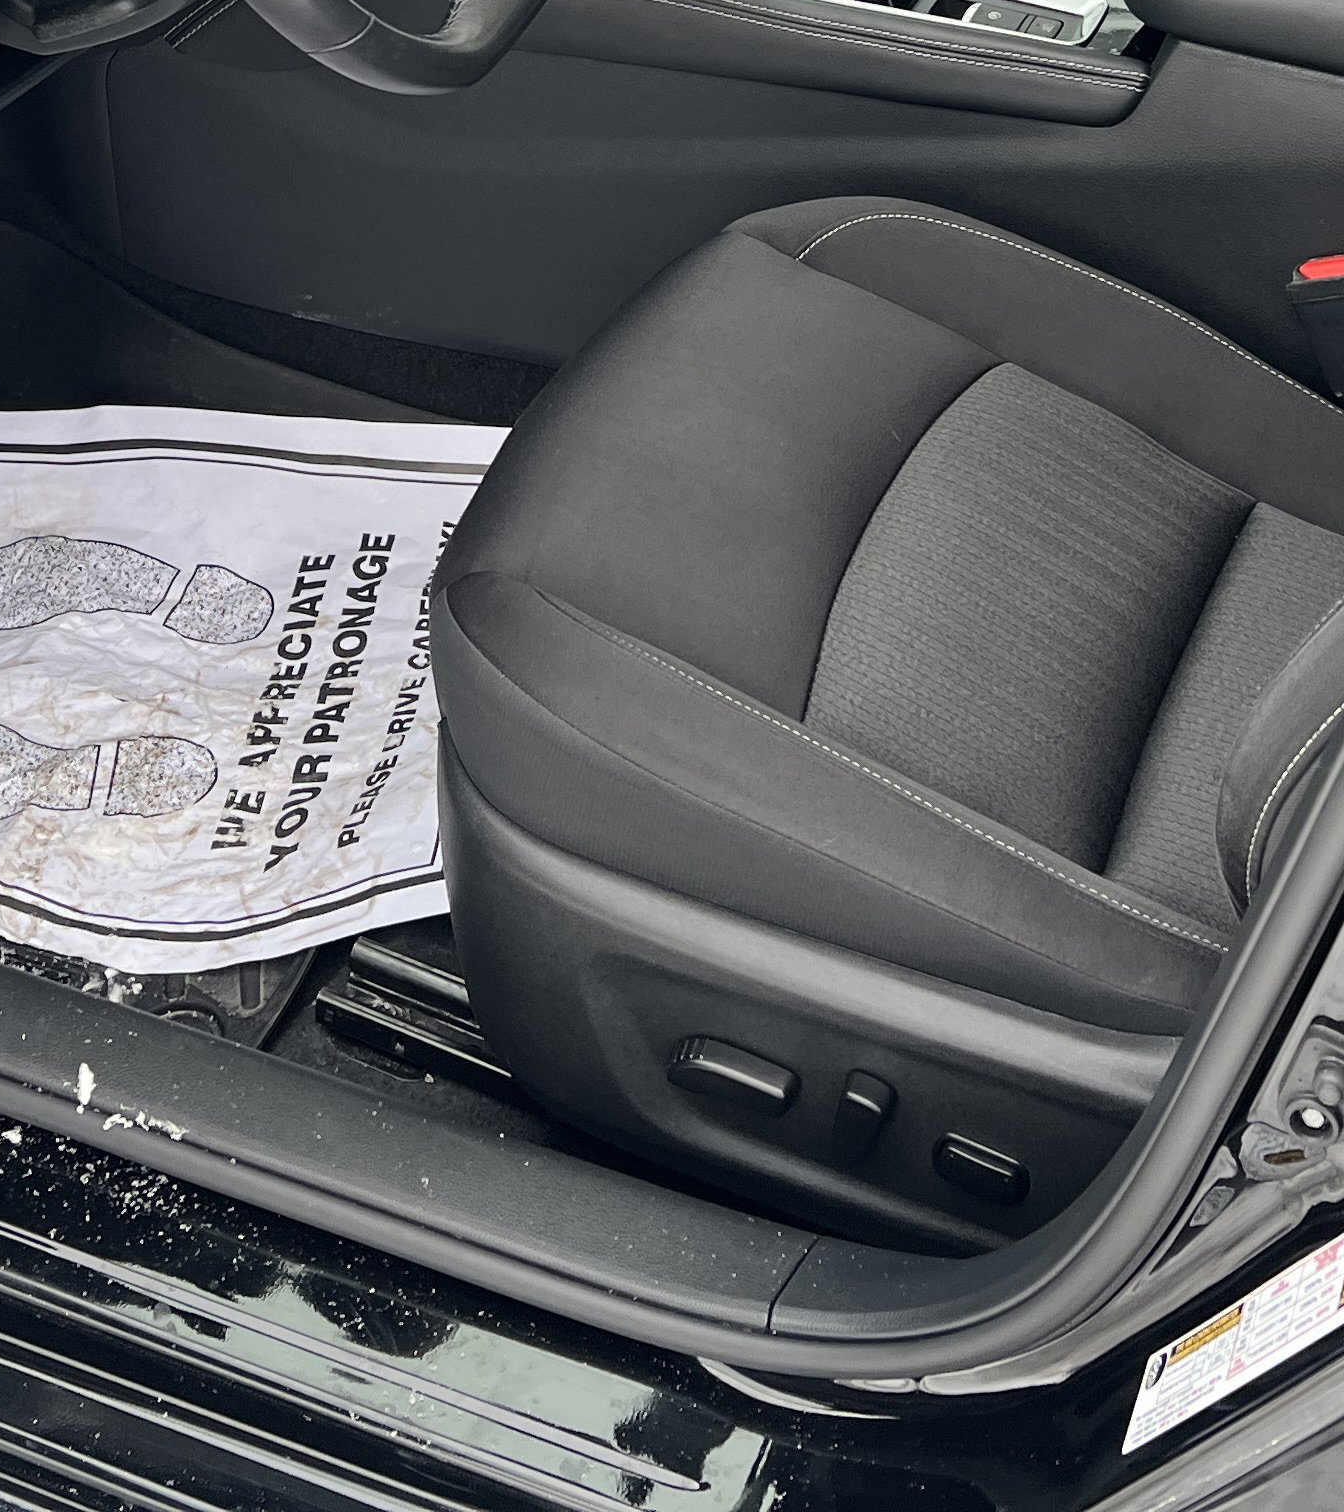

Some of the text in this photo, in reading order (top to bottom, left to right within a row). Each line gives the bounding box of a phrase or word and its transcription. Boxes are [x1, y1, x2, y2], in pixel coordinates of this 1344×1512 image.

[237, 553, 336, 769] APPRECIATE
[263, 532, 396, 873] YOUR PATRONAGE
[337, 754, 399, 849] PLEASE
